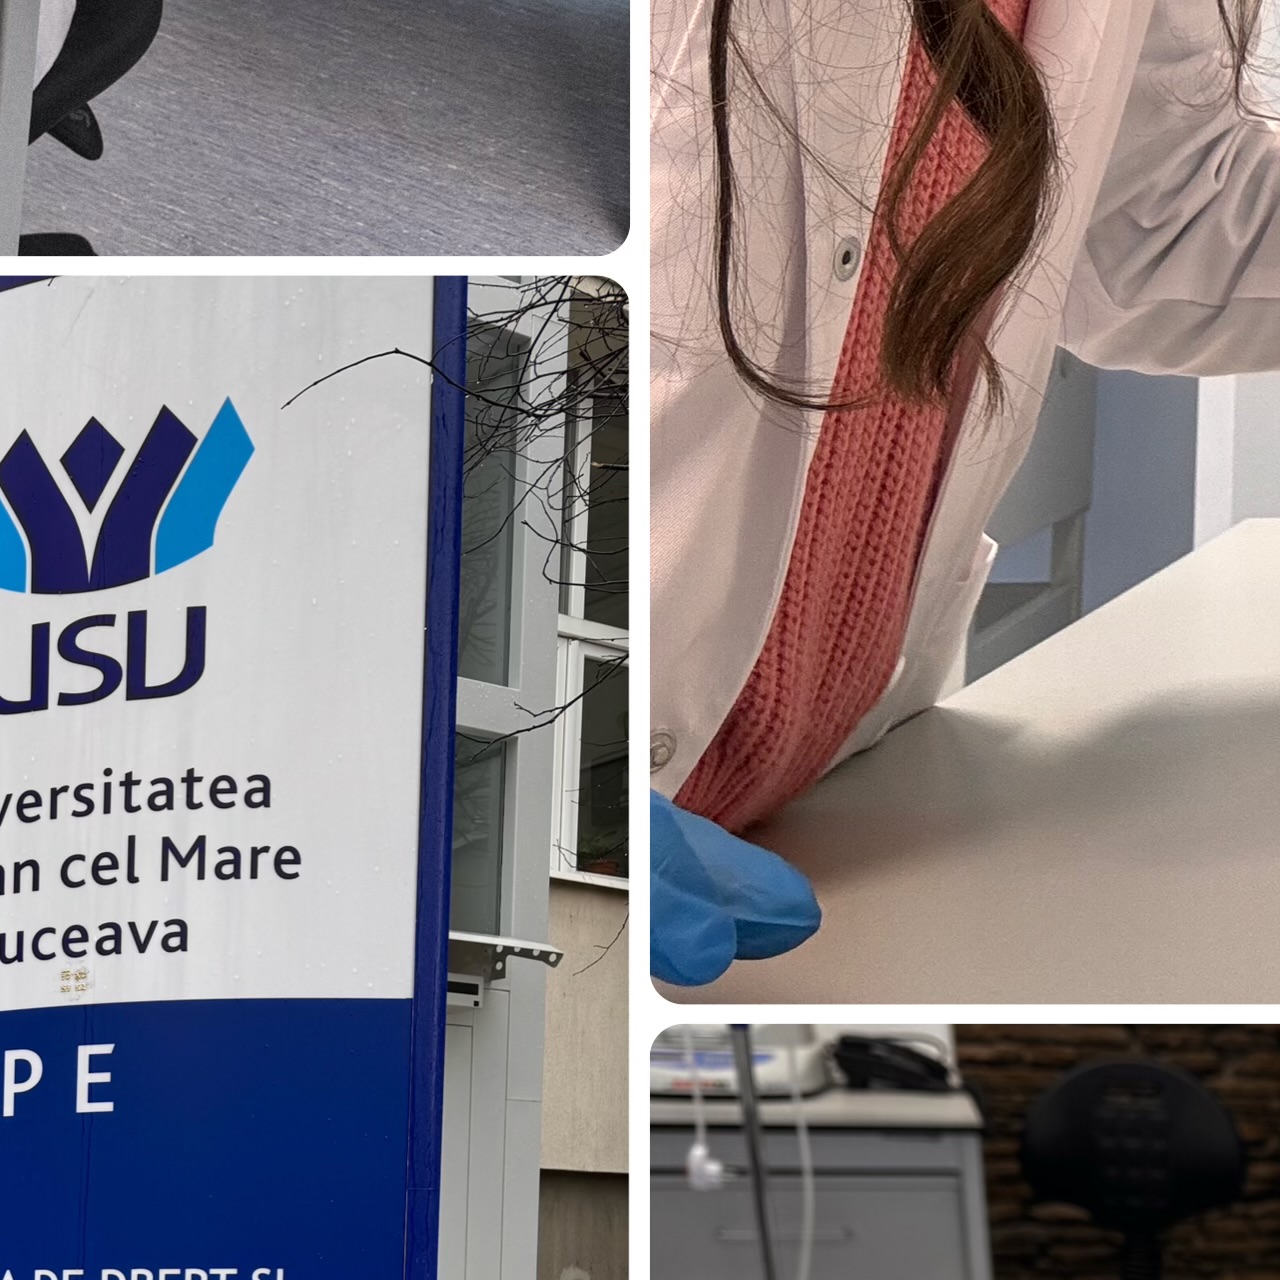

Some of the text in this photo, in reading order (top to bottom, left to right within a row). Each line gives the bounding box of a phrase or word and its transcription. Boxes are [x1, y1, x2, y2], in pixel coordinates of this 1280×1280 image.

[61, 835, 139, 888] cel
[161, 835, 301, 881] Mare
[76, 1044, 114, 1113] E
